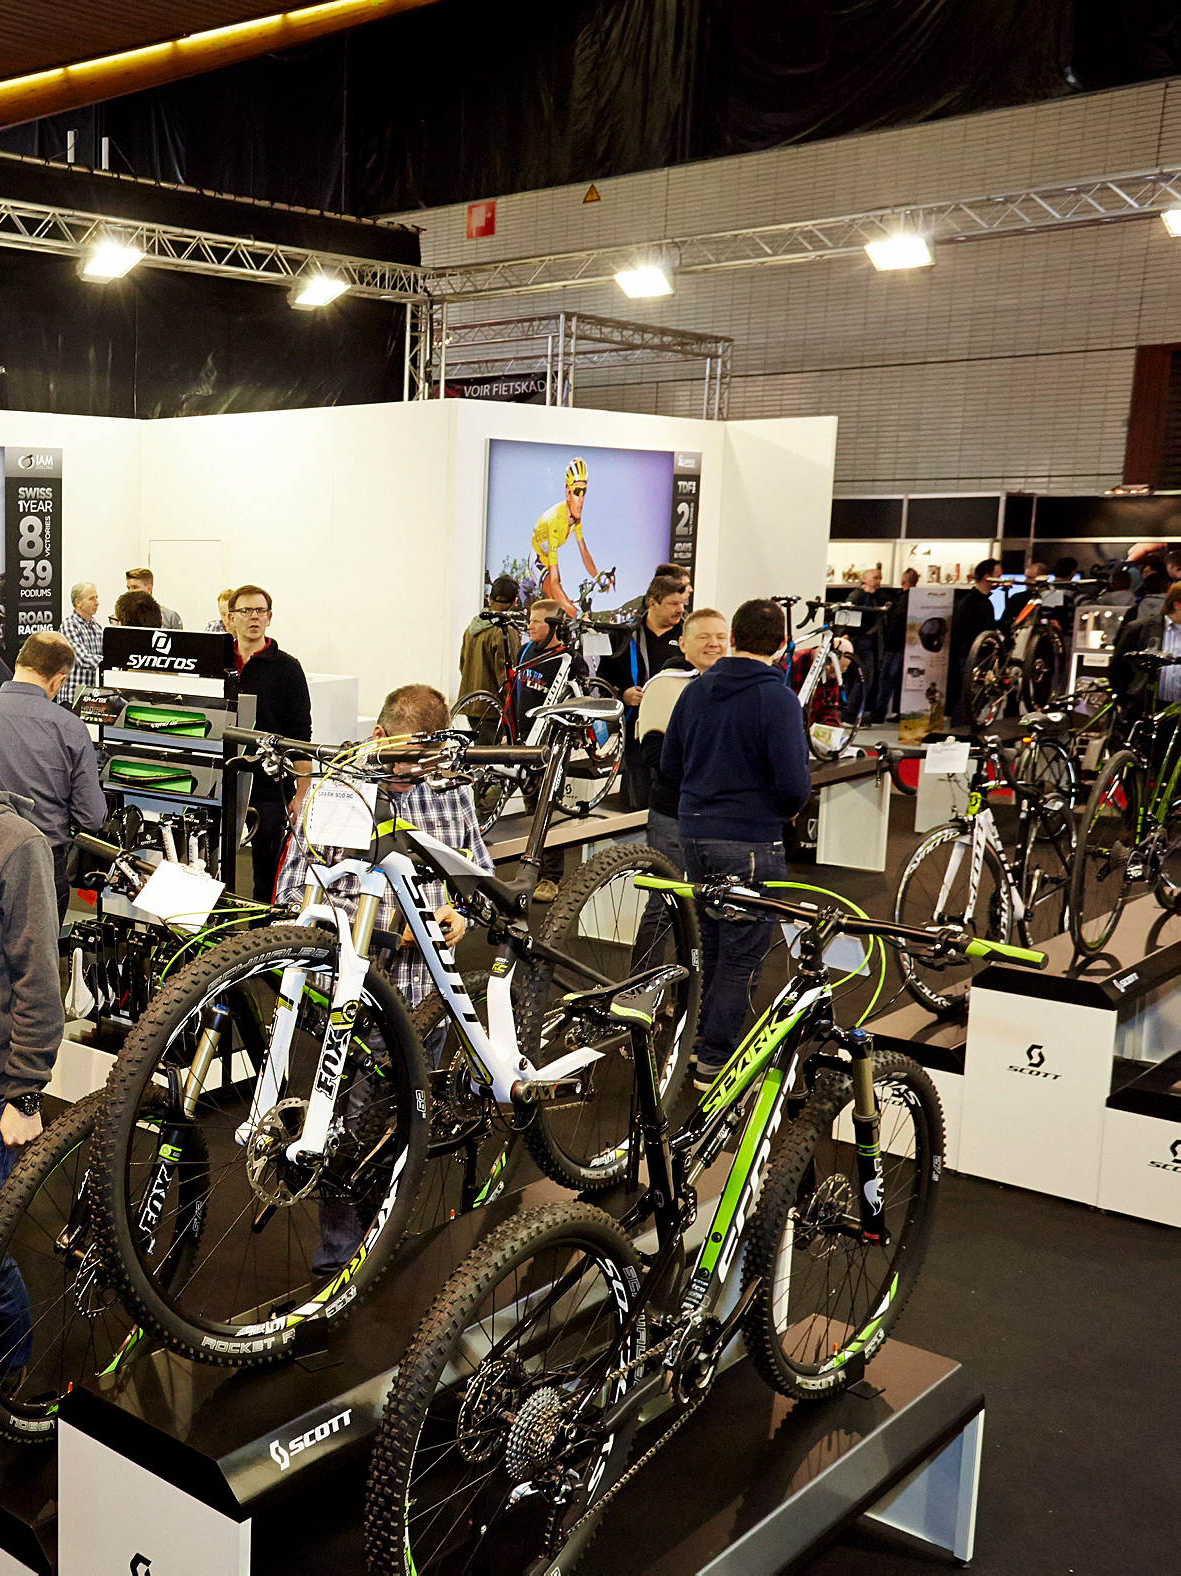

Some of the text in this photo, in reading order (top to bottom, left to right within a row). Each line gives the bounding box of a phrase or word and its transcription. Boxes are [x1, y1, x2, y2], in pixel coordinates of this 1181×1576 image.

[464, 384, 490, 397] VOIR
[492, 380, 547, 396] FIETSKAD
[36, 455, 53, 466] IAM
[18, 487, 53, 500] SWISS
[676, 502, 690, 535] 2
[18, 515, 43, 558] 8
[19, 559, 53, 588] 39
[20, 588, 52, 597] PODIUMS
[18, 611, 53, 624] ROAD
[18, 624, 53, 635] RACING
[127, 654, 197, 670] syncros
[315, 1023, 352, 1100] FOX
[702, 1010, 782, 1122] SPARK
[1007, 1065, 1062, 1080] SCOTT
[1148, 1160, 1181, 1174] SCO
[201, 1336, 275, 1354] ROCKET
[289, 1408, 352, 1457] SCOTT
